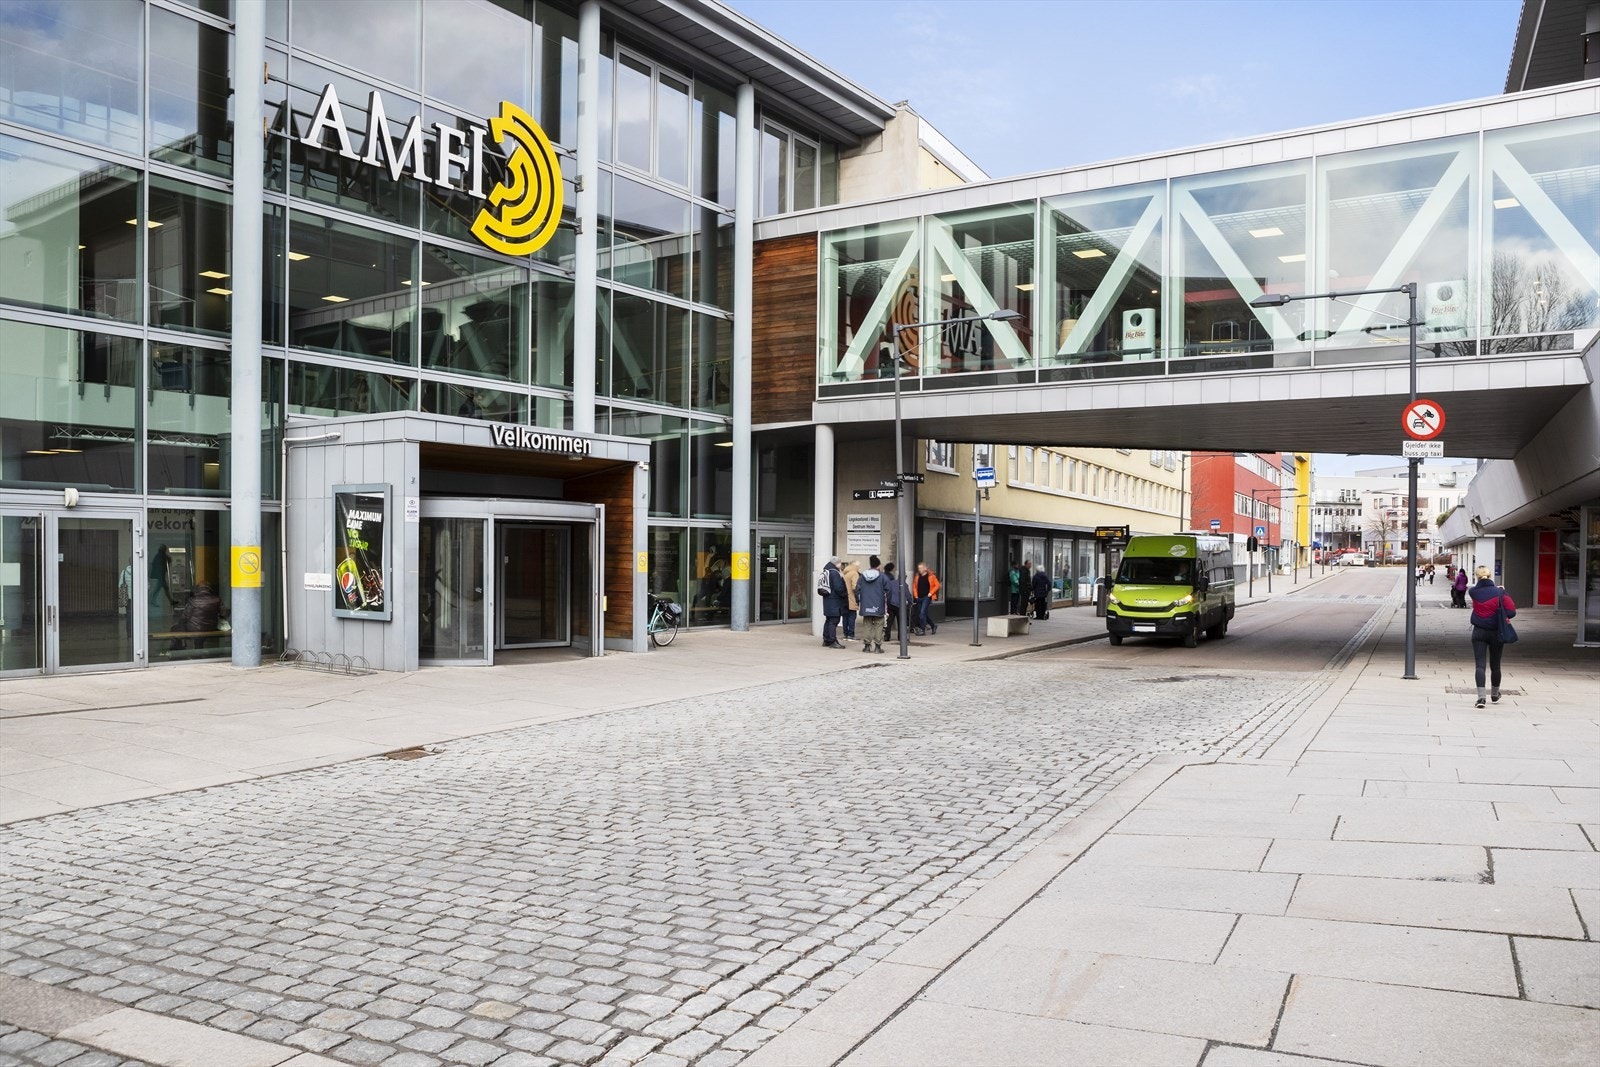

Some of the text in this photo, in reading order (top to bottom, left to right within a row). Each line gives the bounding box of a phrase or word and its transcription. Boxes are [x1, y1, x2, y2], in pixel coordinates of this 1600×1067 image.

[300, 83, 487, 200] AMFI
[1125, 331, 1134, 339] Big
[490, 424, 592, 455] Velkommen
[348, 510, 382, 522] MAXIMUM
